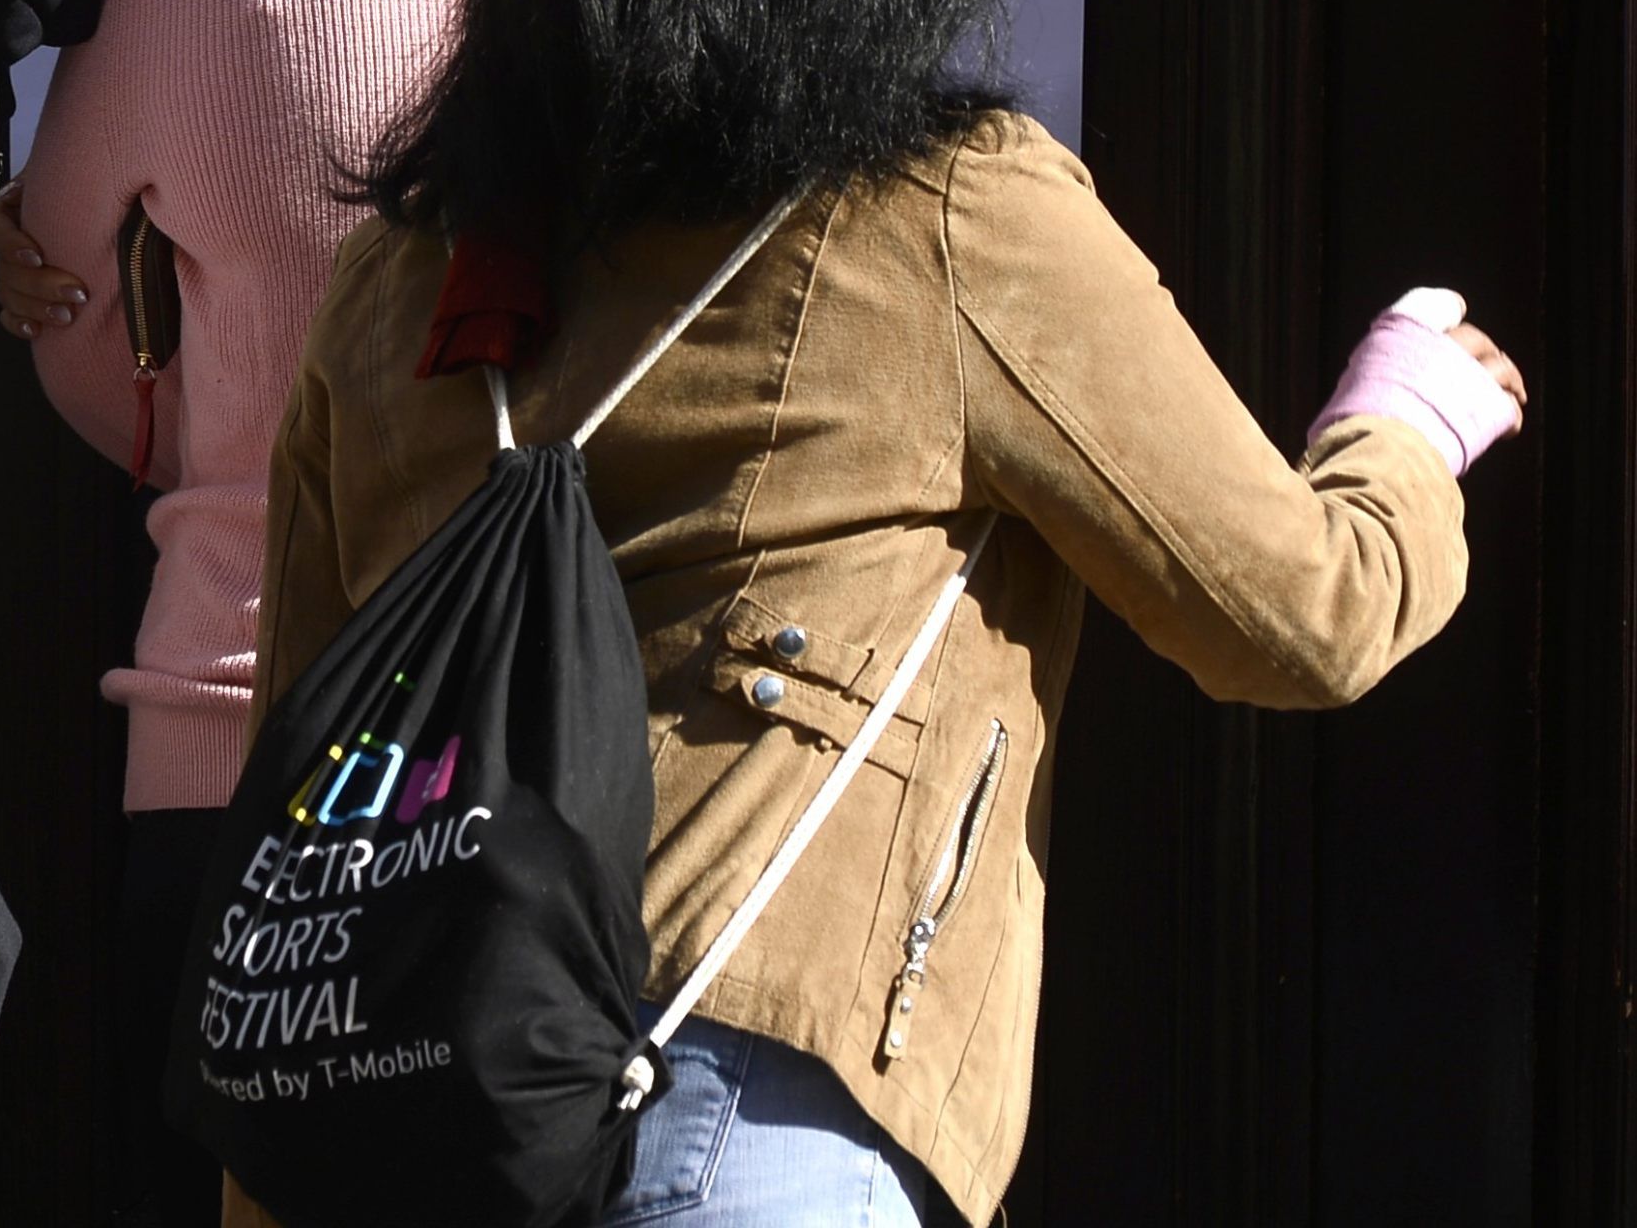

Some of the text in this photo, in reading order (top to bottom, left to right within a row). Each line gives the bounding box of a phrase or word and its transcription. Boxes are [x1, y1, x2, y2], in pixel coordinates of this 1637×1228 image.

[241, 806, 492, 904] EECTRONIC
[272, 1069, 309, 1101] by
[318, 1040, 452, 1089] T-Mobile
